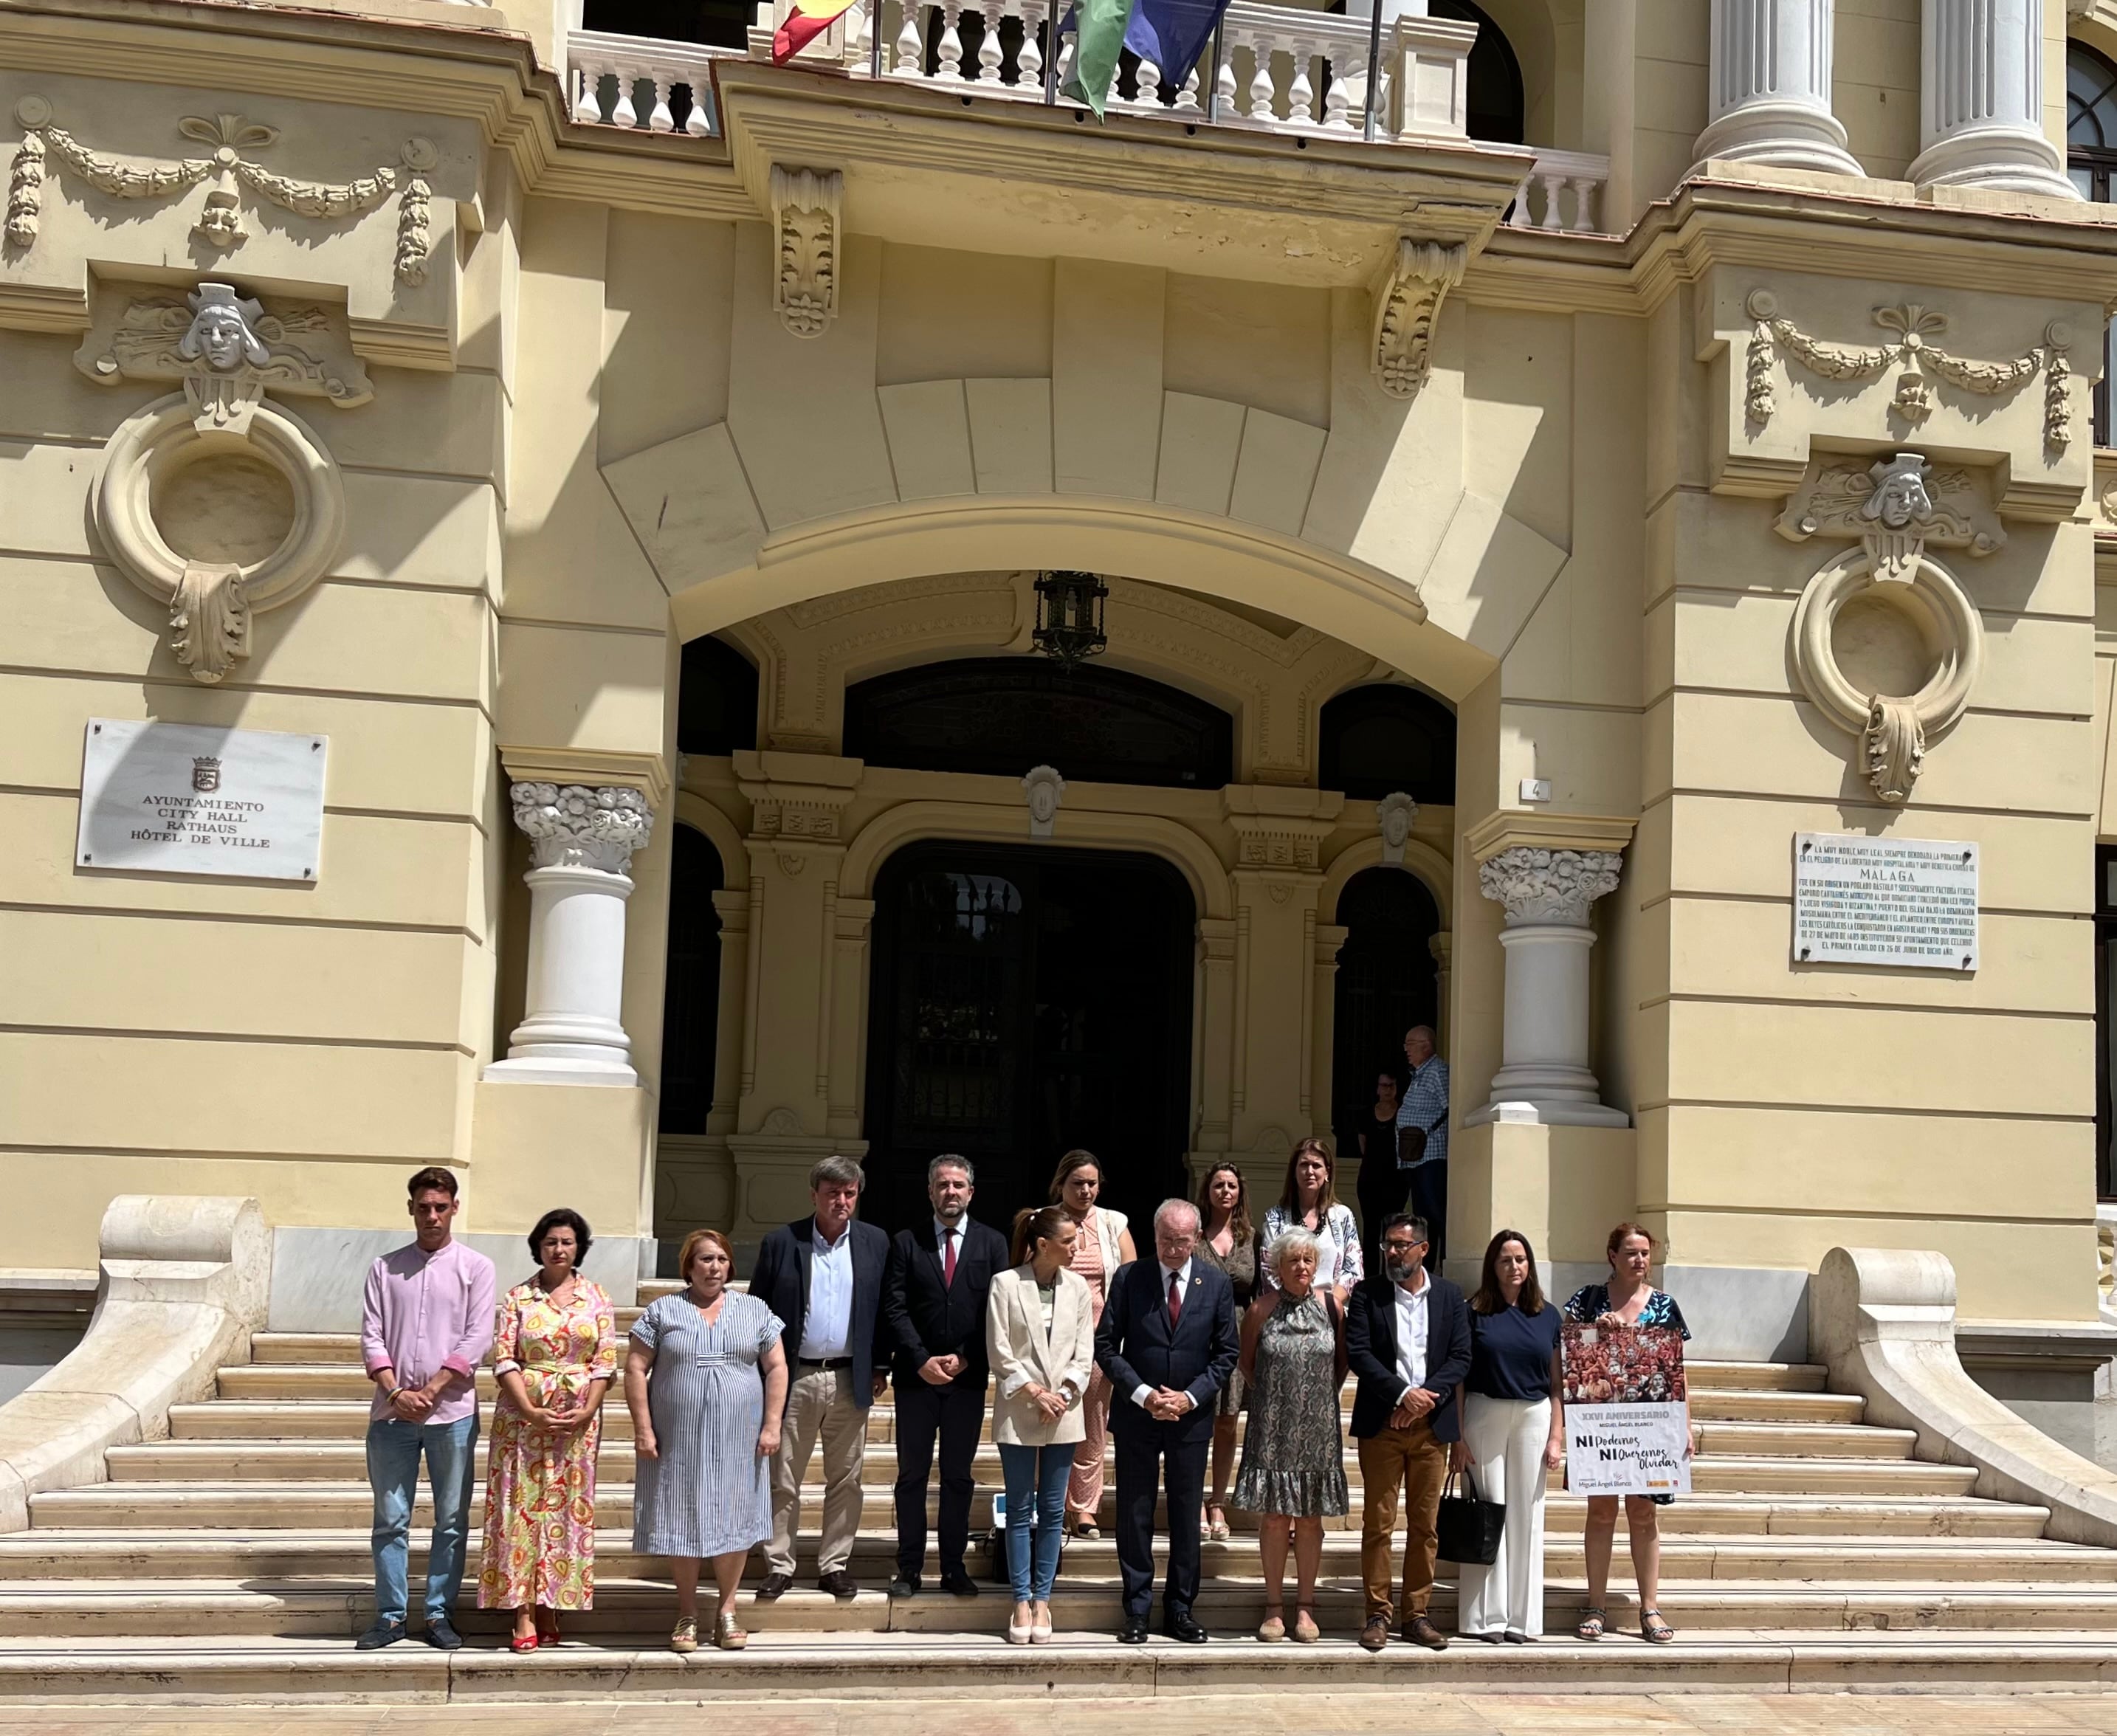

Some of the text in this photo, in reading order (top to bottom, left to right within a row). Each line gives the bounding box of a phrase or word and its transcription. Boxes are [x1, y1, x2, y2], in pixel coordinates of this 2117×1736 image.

[1532, 783, 1541, 796] 4
[142, 796, 264, 812] AYUNTAMIENTO
[158, 808, 247, 822] CITY HALL
[166, 821, 237, 834] RATHAUS
[131, 828, 270, 848] HÔTEL DE VILLE
[1857, 848, 1868, 856] MUY
[1582, 1410, 1670, 1420] XXVI ANIVERSARIO
[1576, 1433, 1640, 1448] NI Podemos
[1600, 1448, 1667, 1461] NI Queremos
[1639, 1456, 1678, 1470] Olvidar
[1597, 1480, 1613, 1488] Ángel
